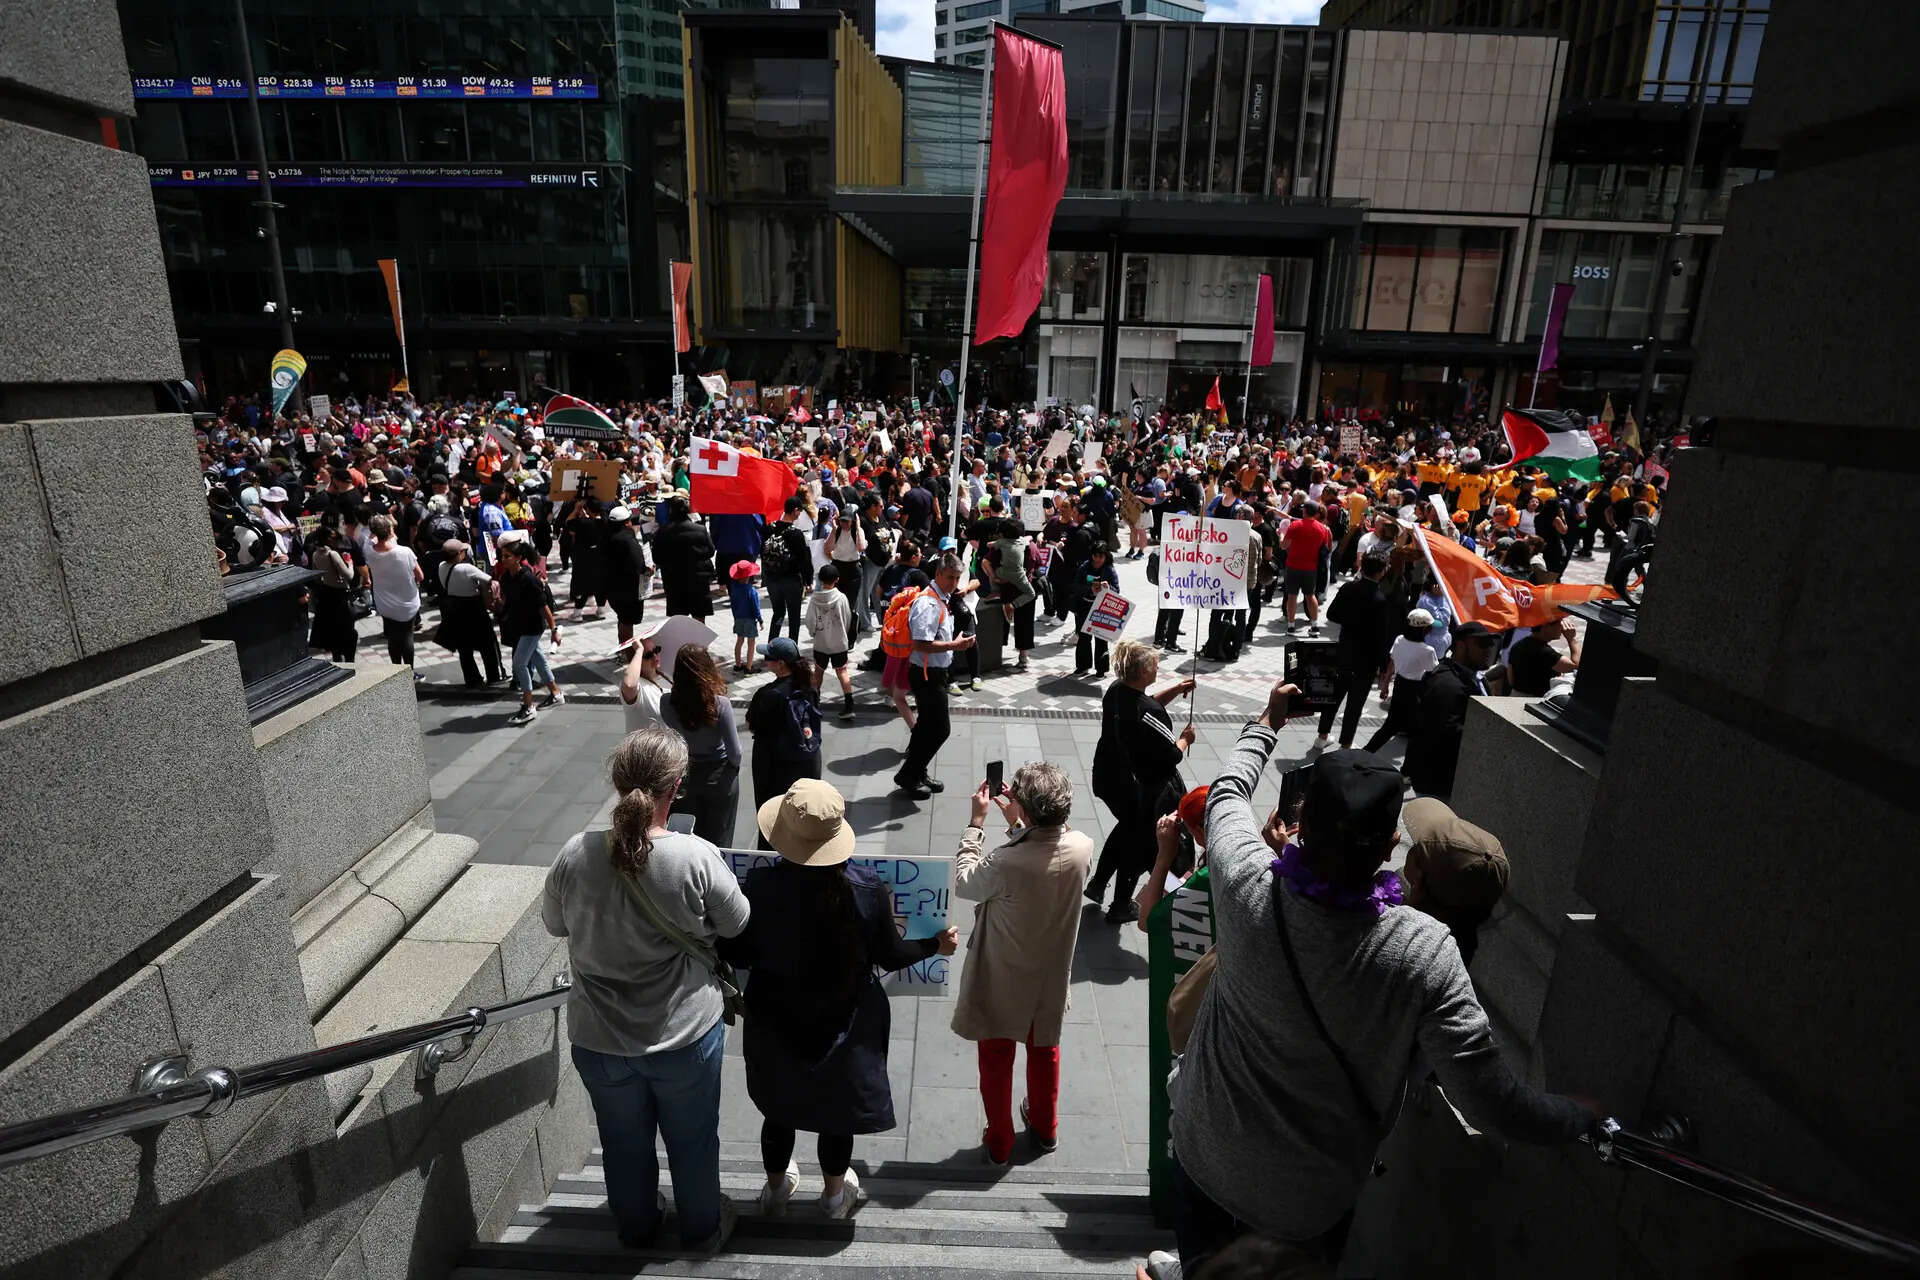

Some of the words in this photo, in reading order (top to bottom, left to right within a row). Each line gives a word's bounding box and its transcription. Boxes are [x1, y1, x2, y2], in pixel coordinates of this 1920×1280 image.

[135, 79, 174, 88] 13342.17
[191, 76, 211, 85] CNU
[217, 79, 241, 88] $9.16
[258, 76, 277, 85] EBO
[283, 79, 313, 88] $28.38
[325, 76, 343, 86] FBU
[350, 79, 374, 88] $3.15
[398, 76, 414, 85] DIV
[422, 79, 447, 88] $1.30
[462, 76, 486, 85] DOW
[532, 76, 552, 85] EMF
[558, 79, 583, 88] $1.89
[1253, 83, 1263, 119] PUBLIC
[197, 170, 211, 179] JPY
[278, 169, 302, 177] 0.5736
[530, 174, 577, 184] REFINITIV
[1572, 265, 1609, 279] BOSS
[1168, 517, 1228, 545] Tautoko
[1166, 567, 1222, 590] tautoko
